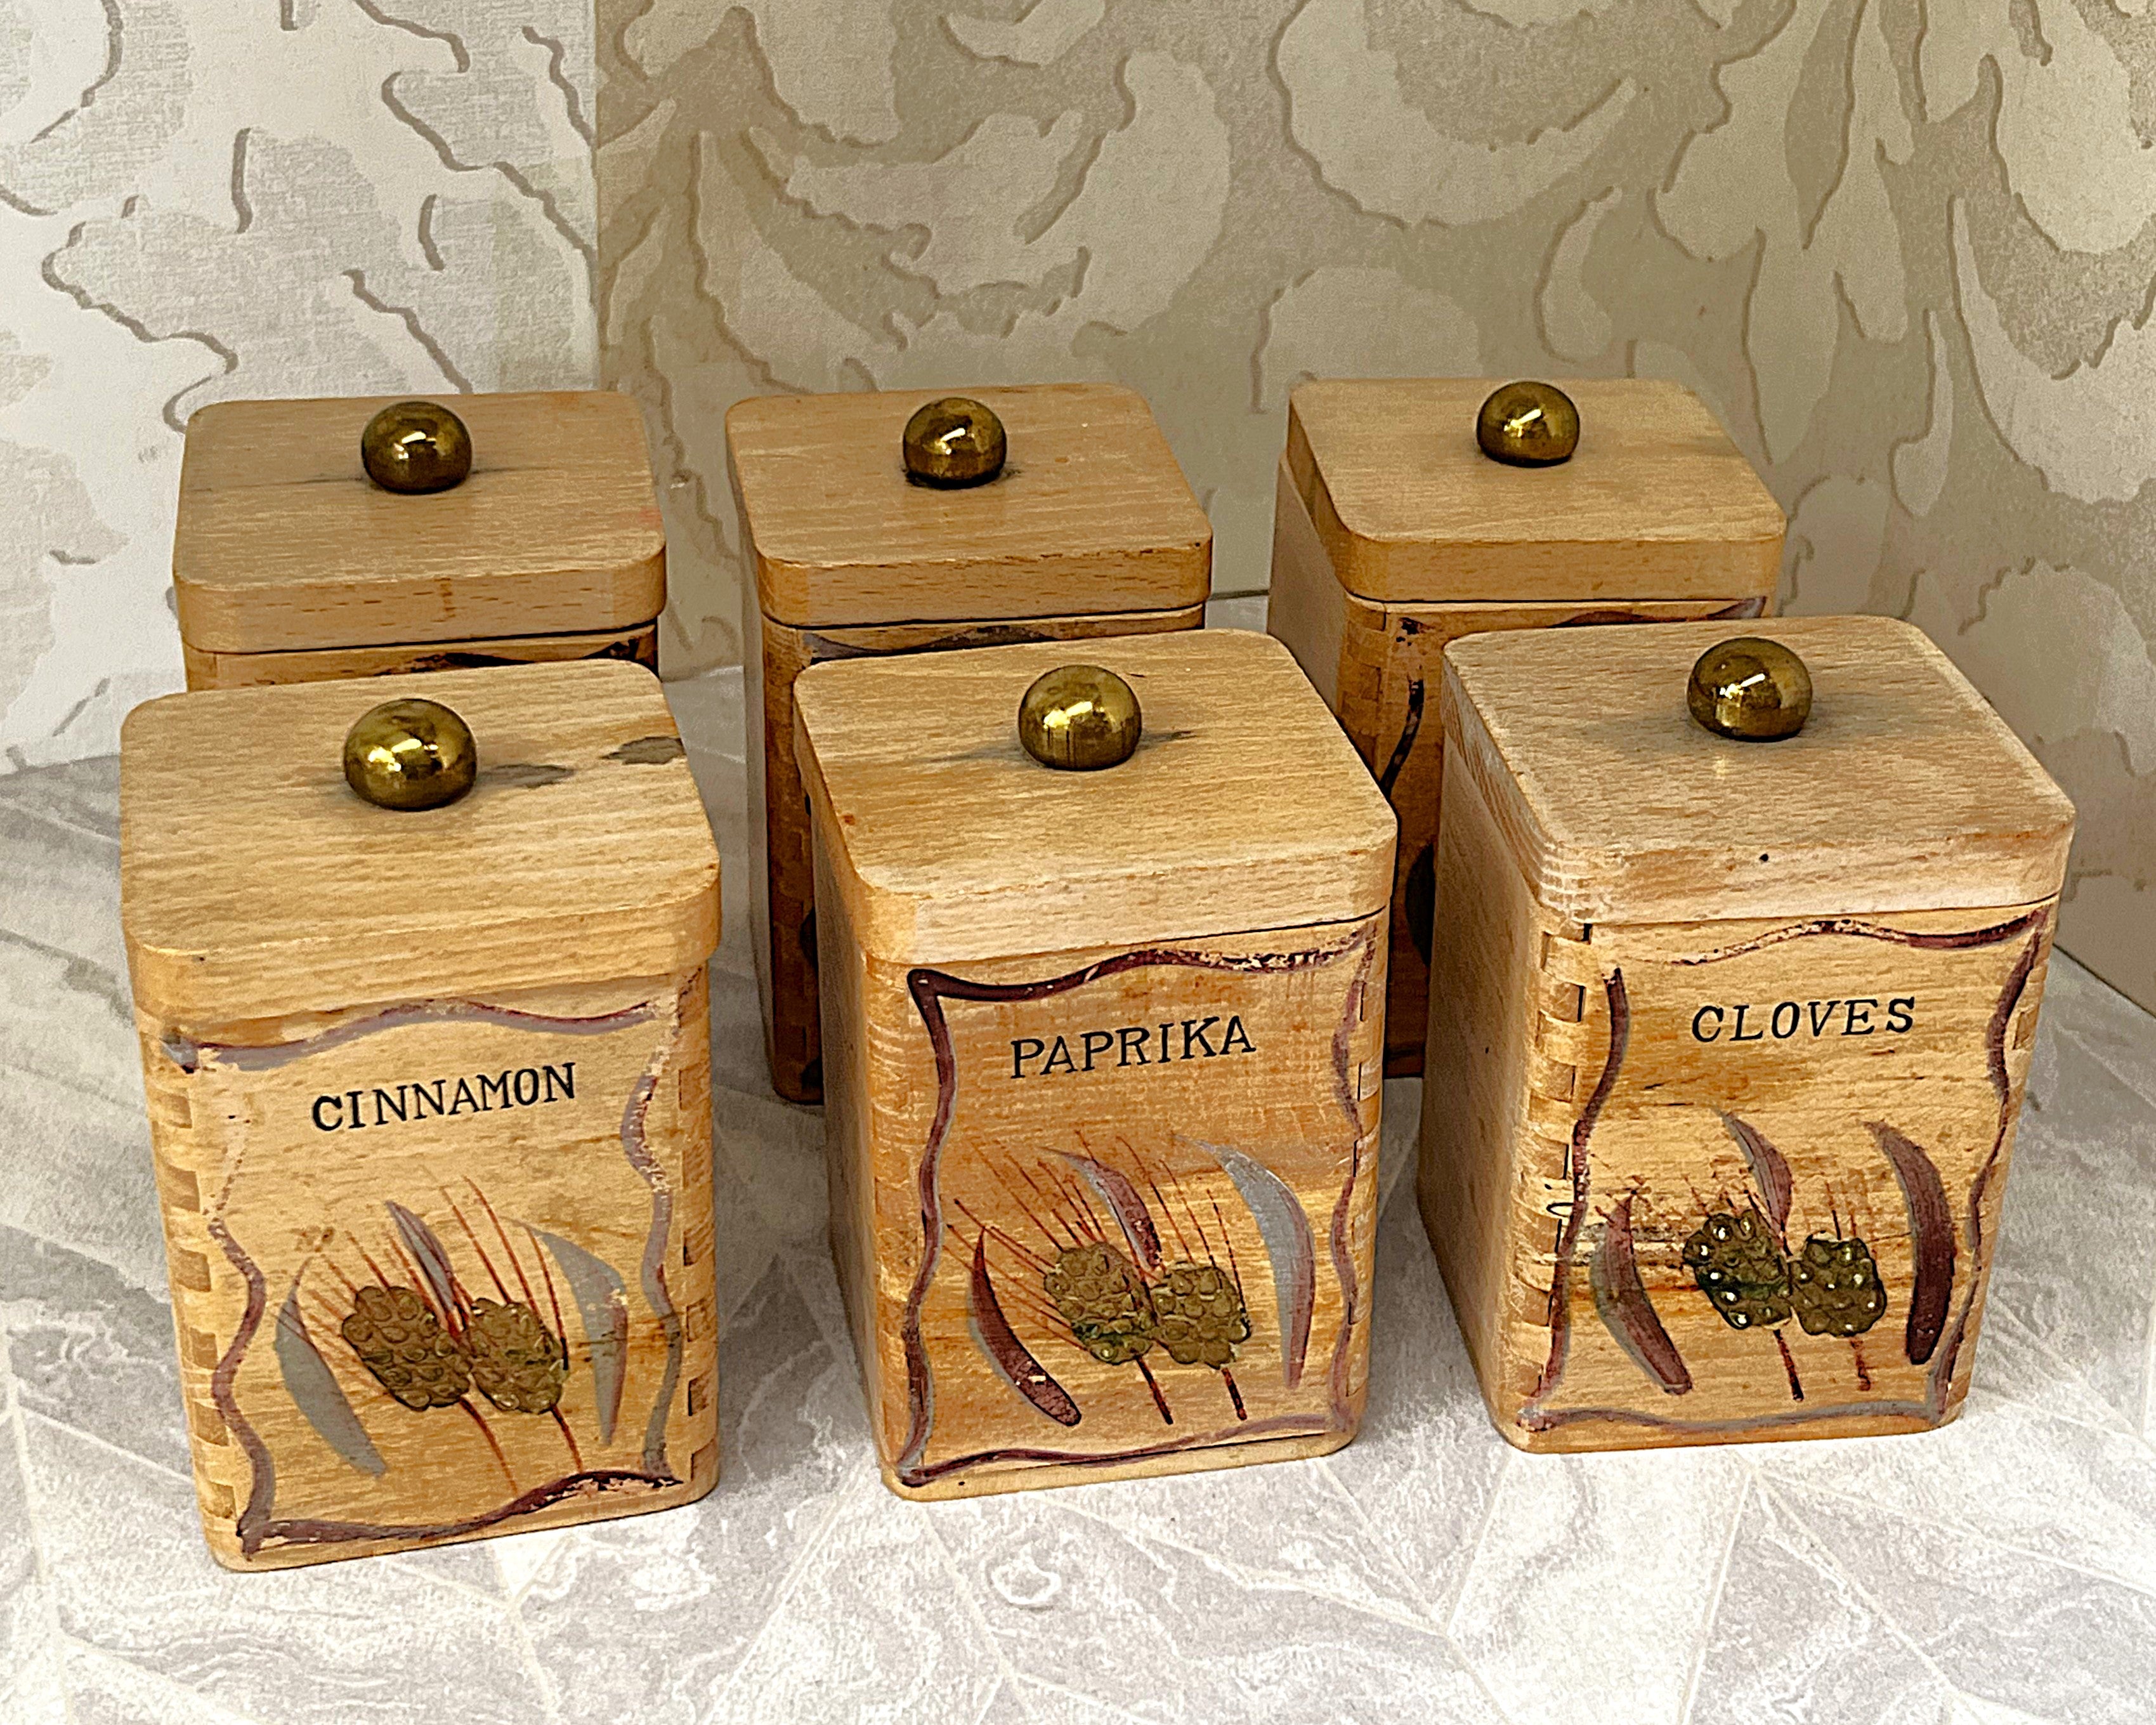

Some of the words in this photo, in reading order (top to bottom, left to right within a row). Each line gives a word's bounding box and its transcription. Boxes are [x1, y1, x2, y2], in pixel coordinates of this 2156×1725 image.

[1010, 1016, 1256, 1079] PAPRIKA
[1692, 997, 1914, 1042] CLOVES
[313, 1063, 575, 1131] CINNAMON
